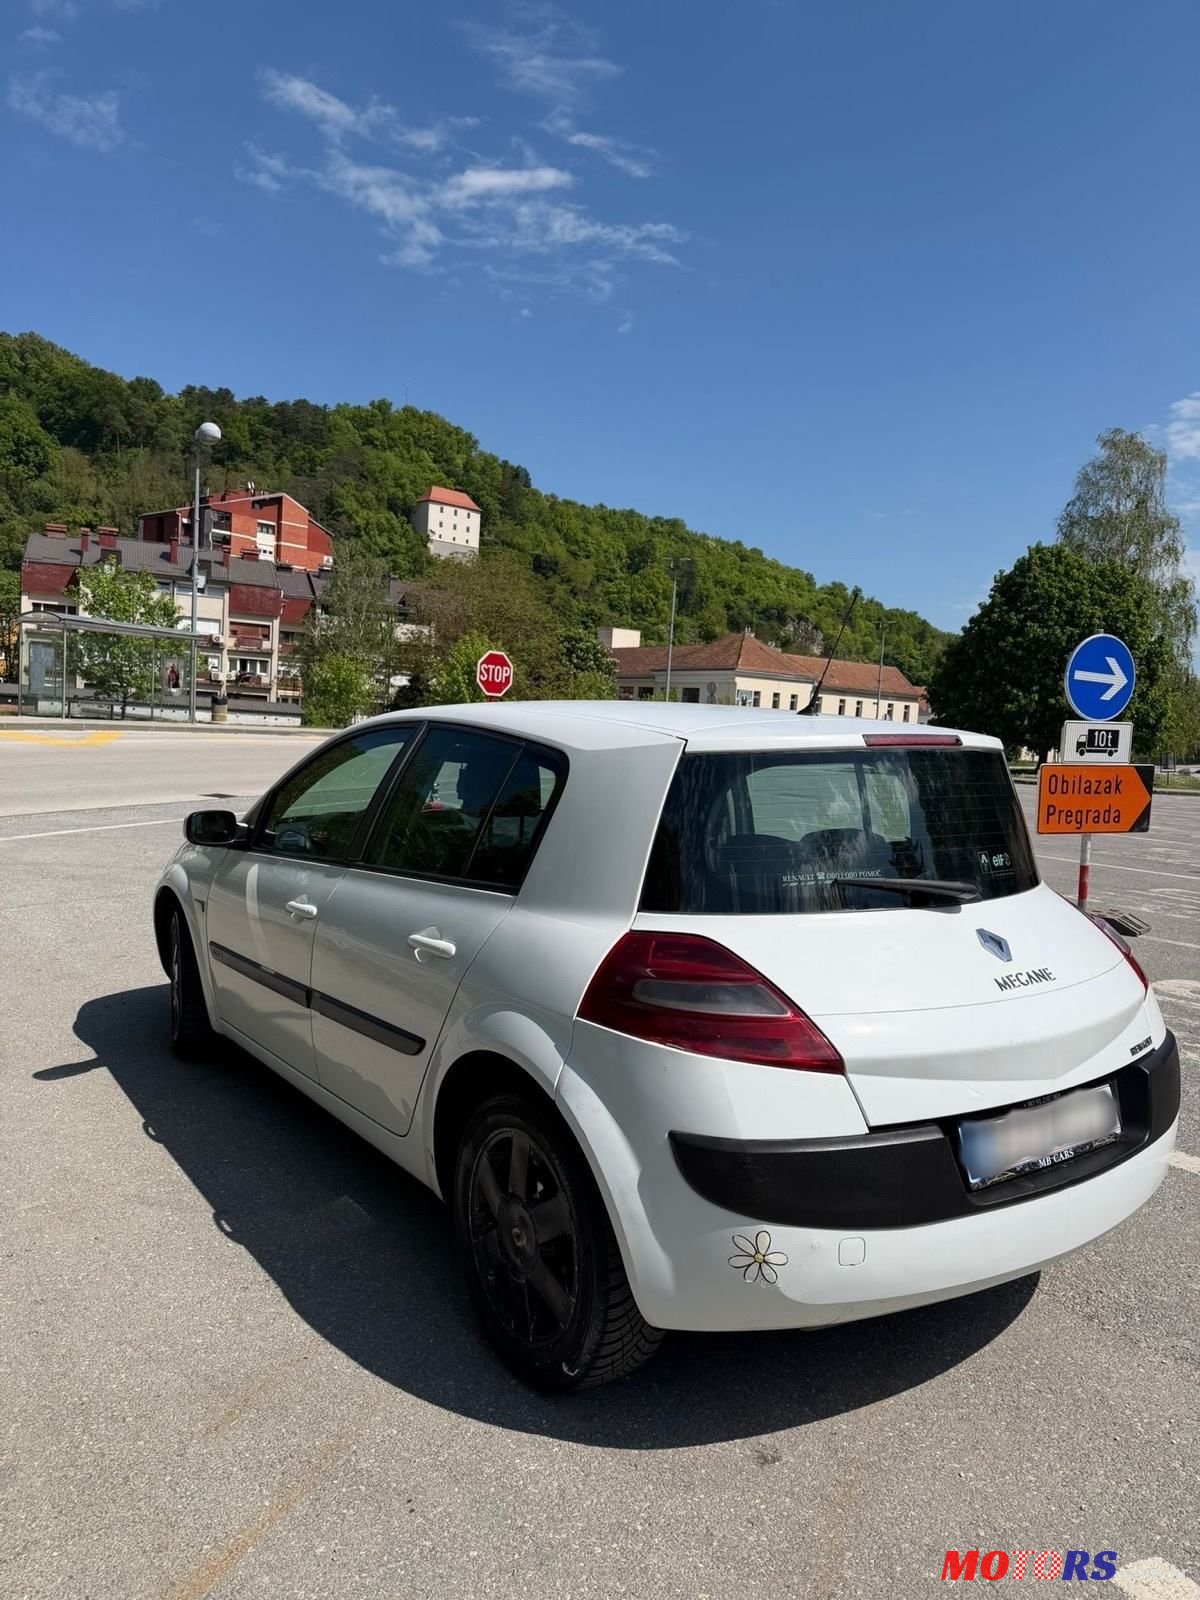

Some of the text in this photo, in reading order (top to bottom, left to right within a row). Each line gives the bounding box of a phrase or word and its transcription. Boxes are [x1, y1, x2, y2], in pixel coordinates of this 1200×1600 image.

[480, 664, 511, 683] STOP
[1094, 730, 1113, 747] 10t
[1048, 773, 1123, 795] Obilazak
[1046, 804, 1121, 831] Pregrada
[1038, 1148, 1075, 1168] MB CARS
